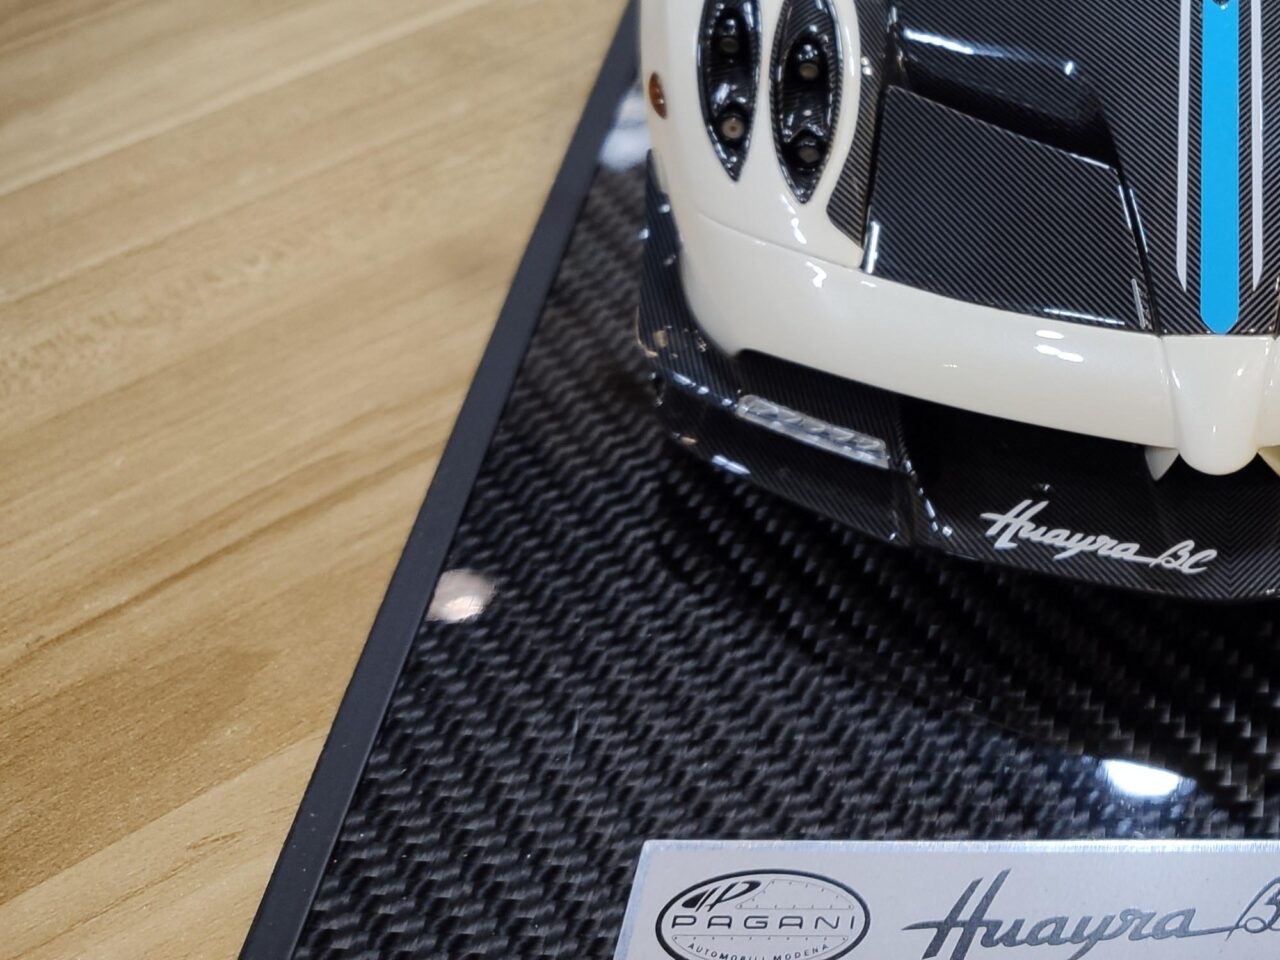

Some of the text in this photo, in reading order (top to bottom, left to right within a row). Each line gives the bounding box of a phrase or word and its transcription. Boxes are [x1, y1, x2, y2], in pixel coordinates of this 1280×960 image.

[980, 499, 1217, 574] Huayra BC
[671, 915, 855, 930] PAGANI
[902, 868, 1228, 960] Huayra
[773, 942, 830, 960] MODENA
